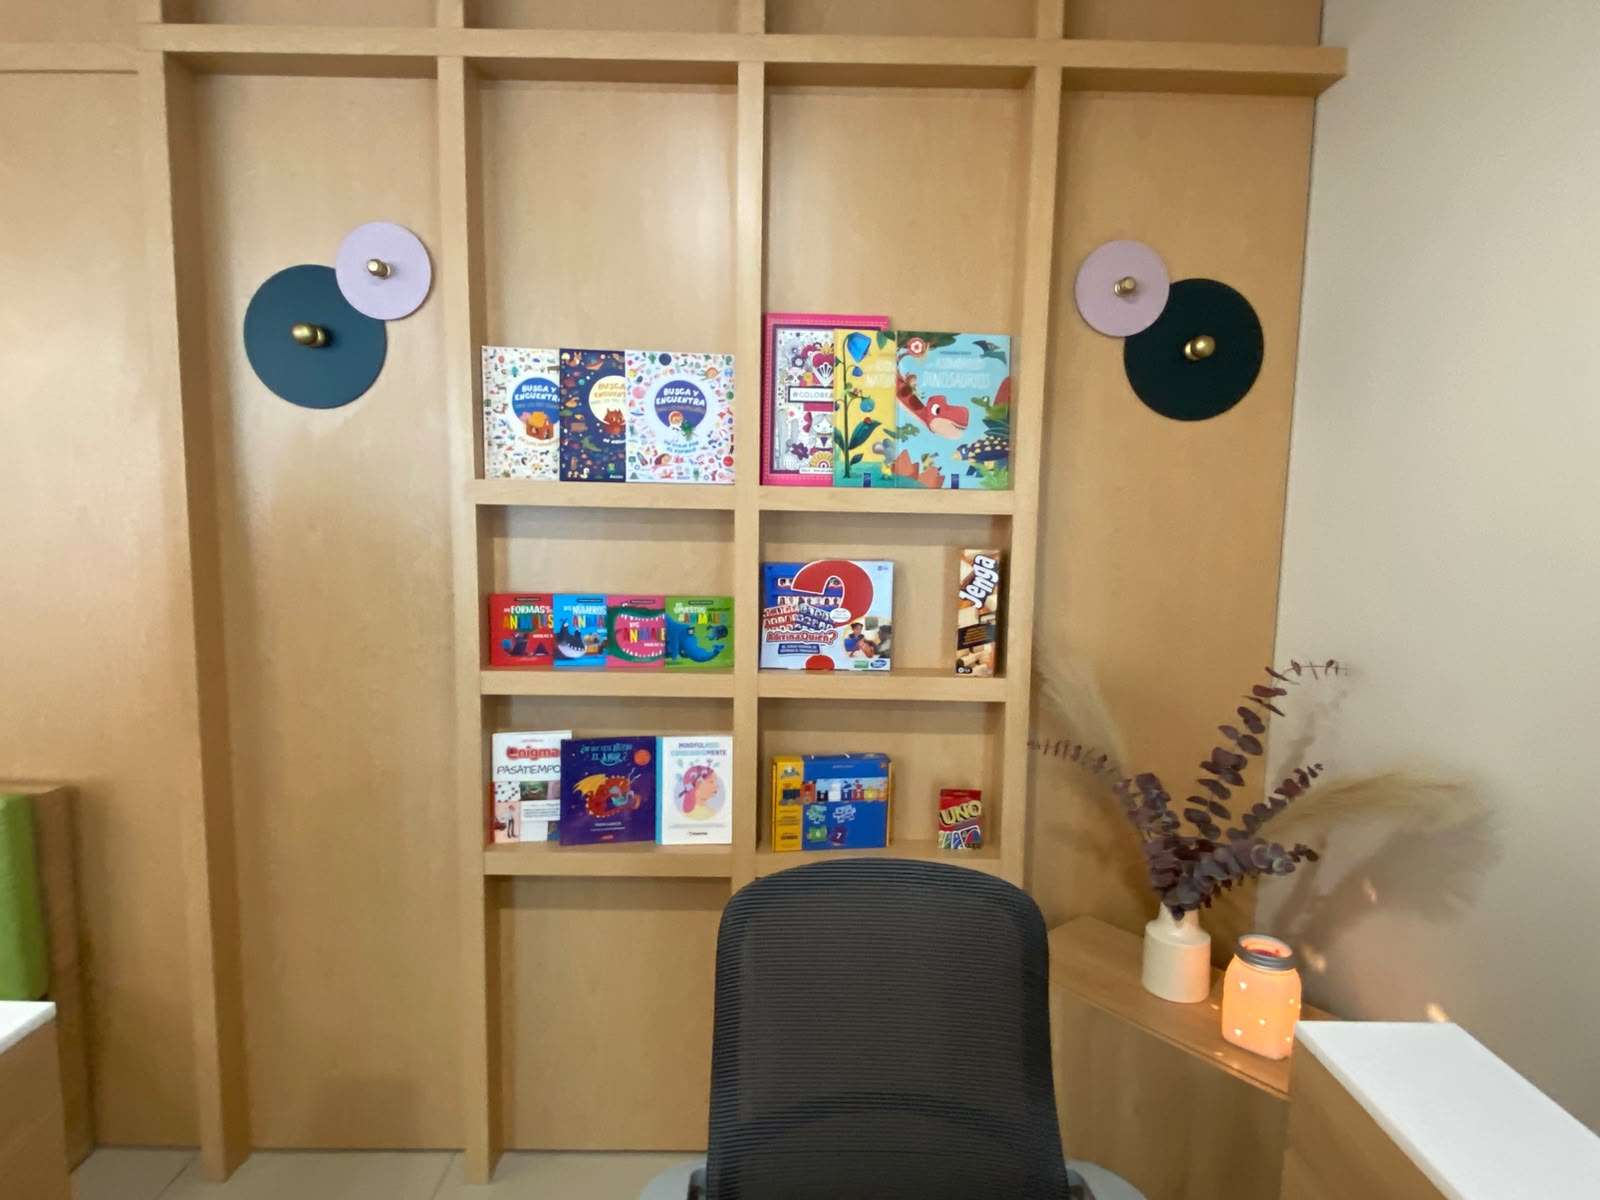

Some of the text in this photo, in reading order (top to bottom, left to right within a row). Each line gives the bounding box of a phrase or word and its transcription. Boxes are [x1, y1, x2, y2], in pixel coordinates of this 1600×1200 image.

[521, 384, 549, 393] BUSCA
[663, 387, 691, 397] BUSCA
[656, 396, 705, 407] ENCUENTRA
[958, 554, 998, 609] Jenga
[940, 799, 982, 827] UNO
